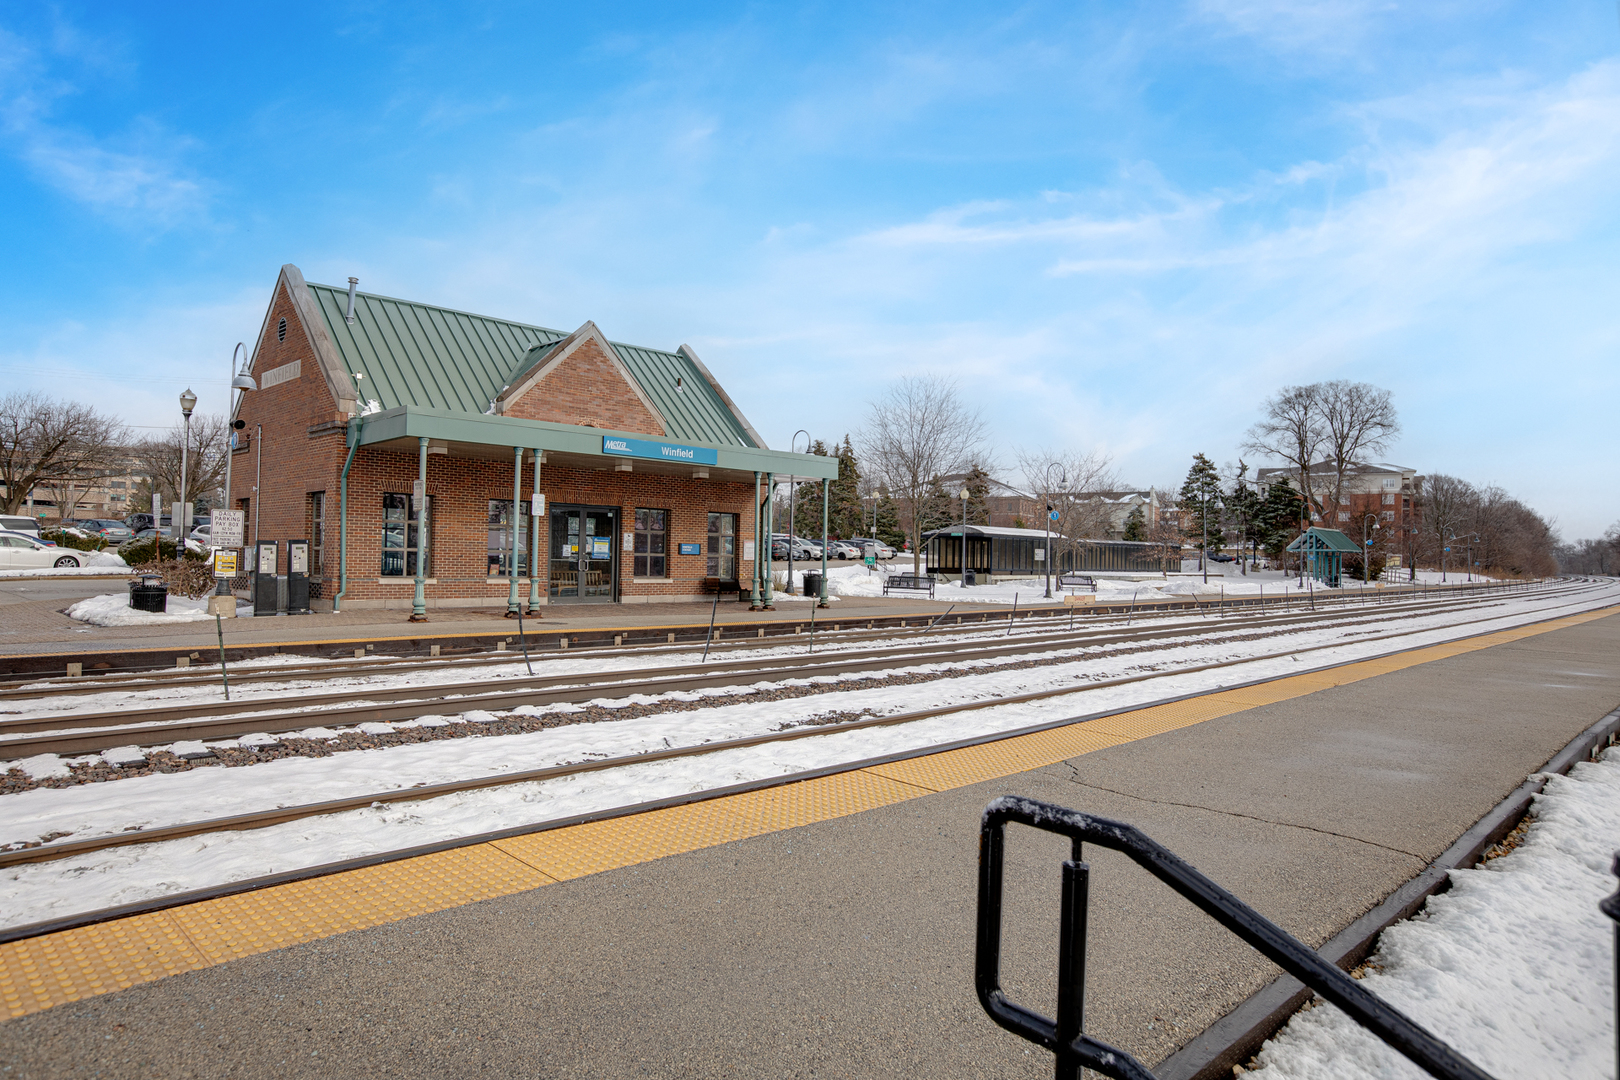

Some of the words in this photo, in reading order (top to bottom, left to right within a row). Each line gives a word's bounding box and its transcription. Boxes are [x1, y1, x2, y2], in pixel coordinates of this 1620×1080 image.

[264, 363, 299, 386] WINFIELD
[604, 440, 626, 449] Metra
[661, 446, 694, 458] Winfield
